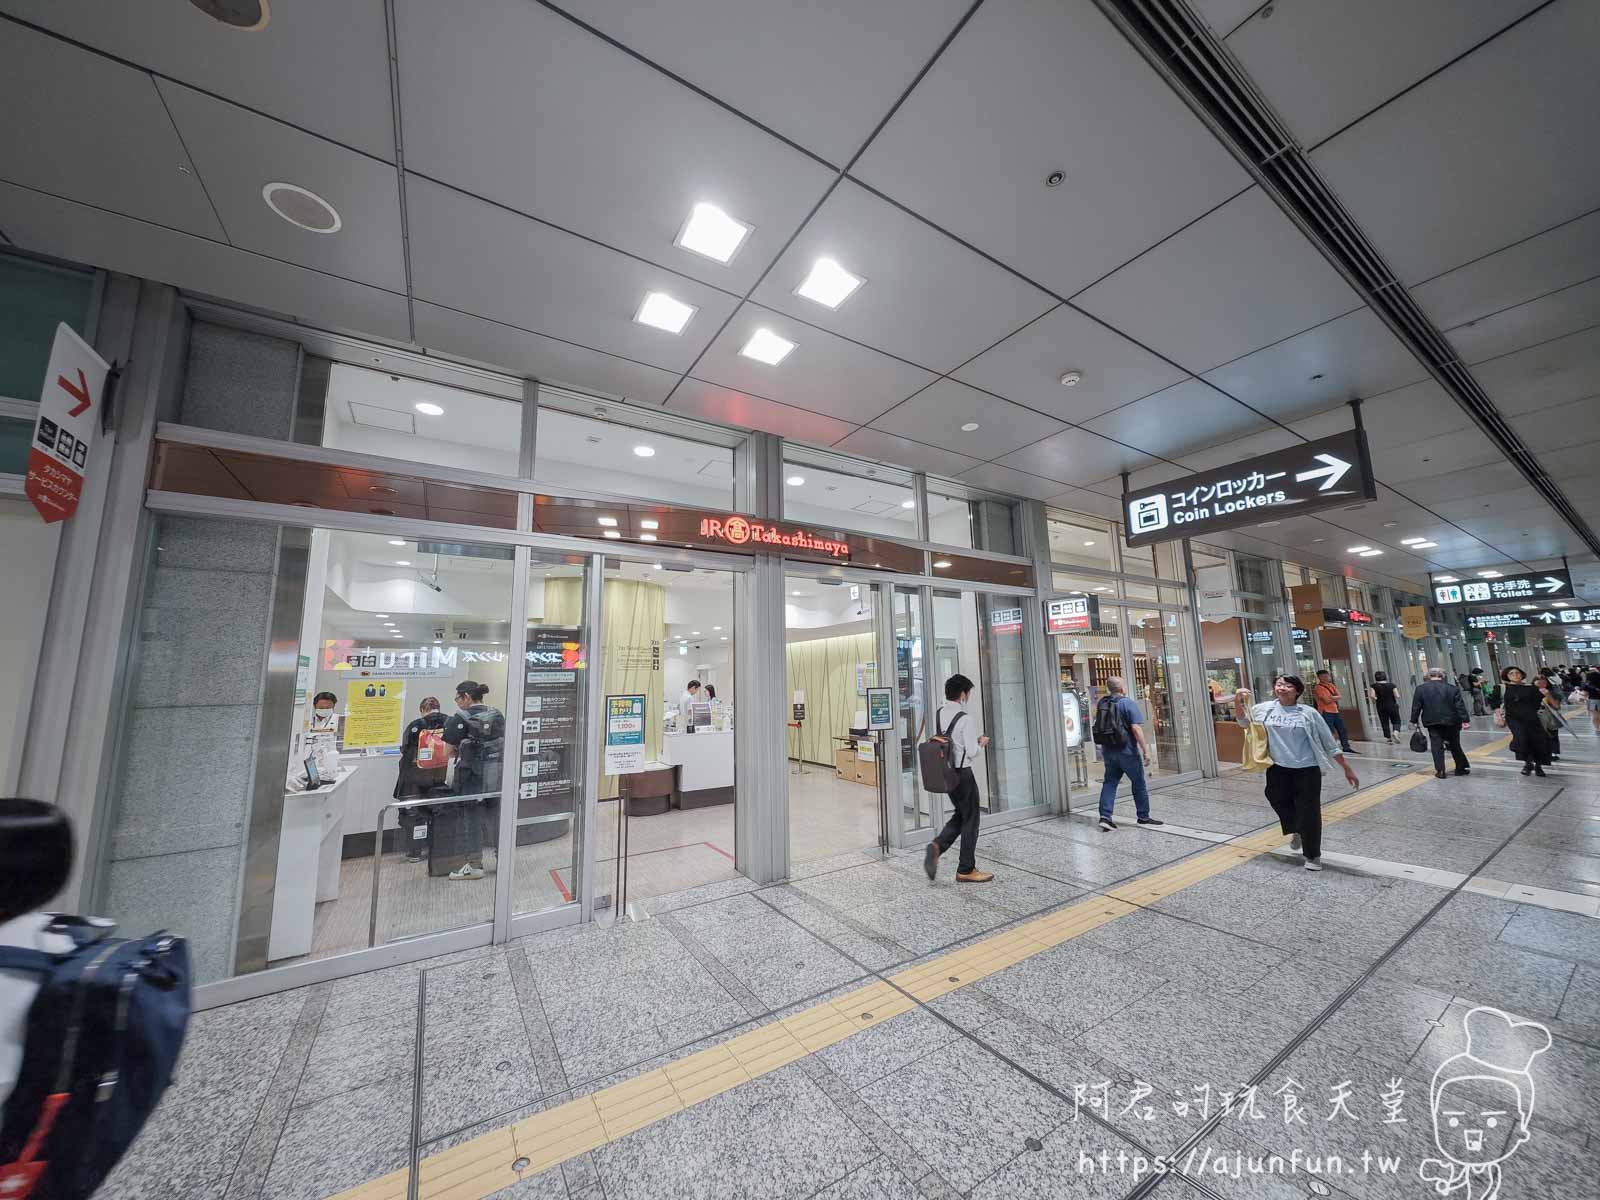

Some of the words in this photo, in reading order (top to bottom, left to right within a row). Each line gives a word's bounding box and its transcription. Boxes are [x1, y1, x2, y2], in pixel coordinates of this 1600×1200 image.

[1171, 471, 1287, 509] コインロッカー
[1173, 507, 1210, 525] Coin
[1214, 489, 1286, 515] Lockers
[751, 525, 849, 556] Takashimaya
[1491, 579, 1531, 592] お手洗
[1494, 589, 1534, 599] Toilets
